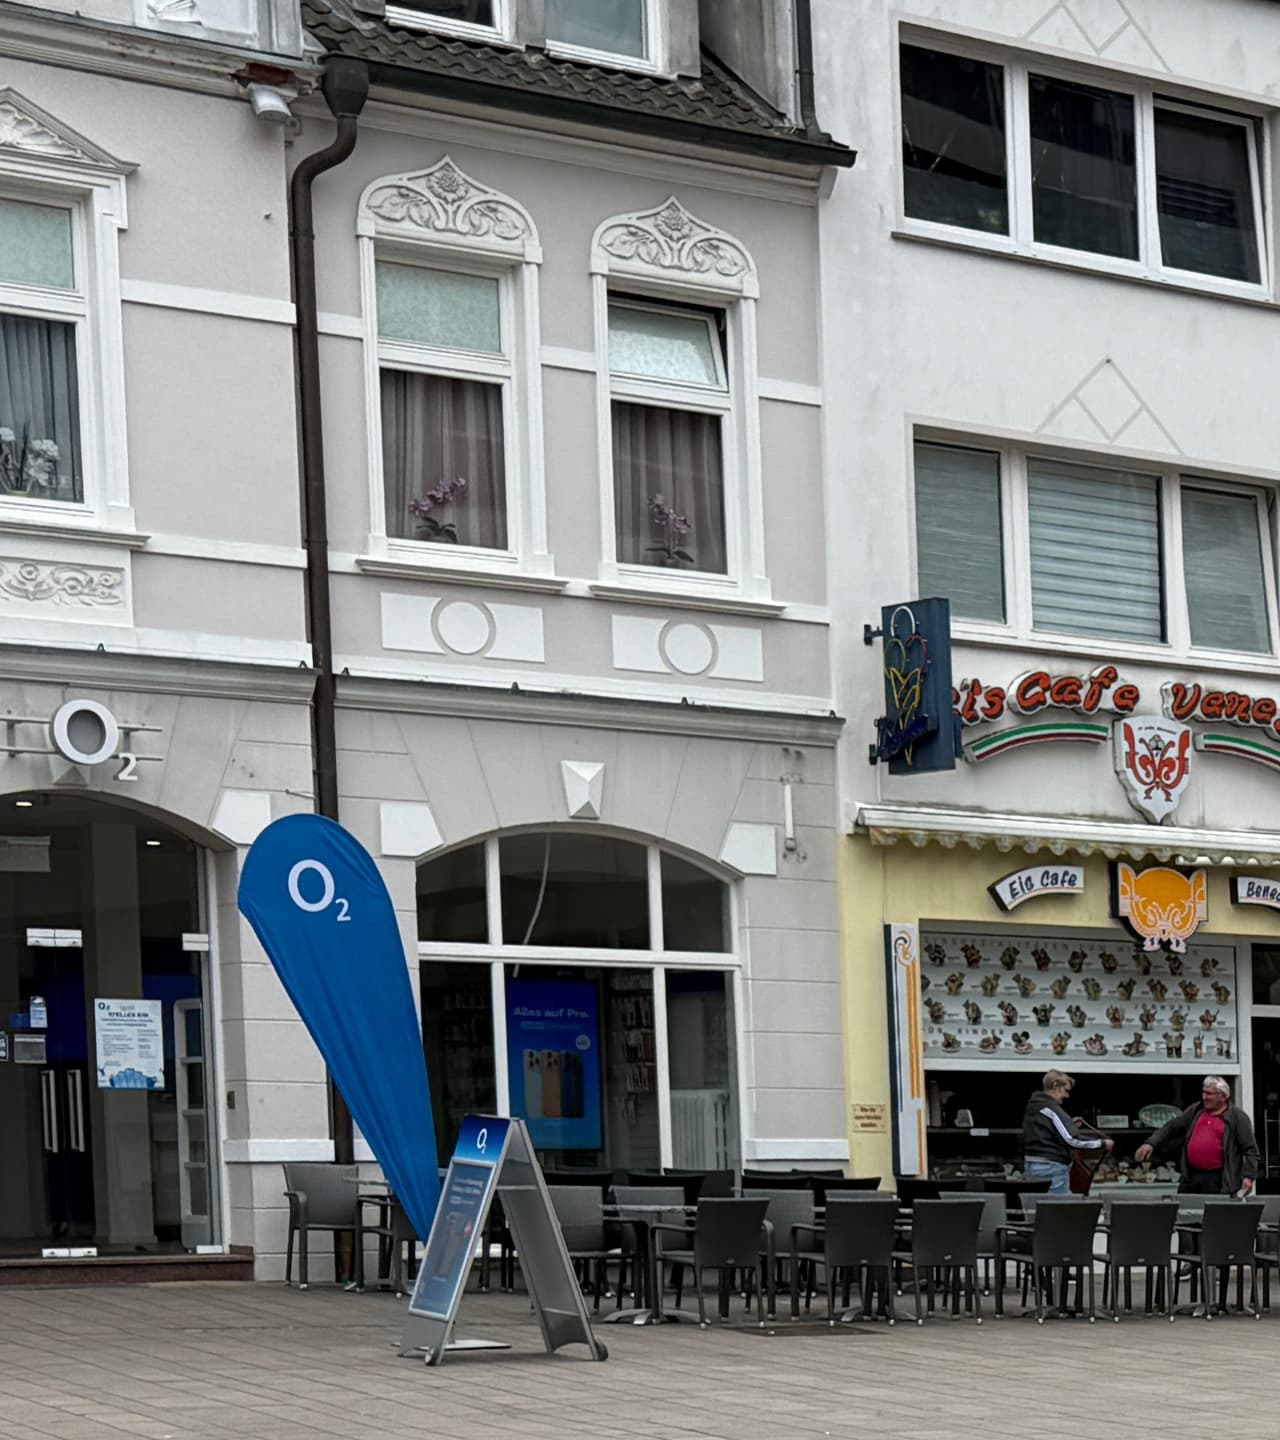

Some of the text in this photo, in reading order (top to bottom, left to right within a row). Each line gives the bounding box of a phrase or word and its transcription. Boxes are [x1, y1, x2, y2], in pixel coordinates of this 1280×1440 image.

[953, 678, 1007, 722] is
[1013, 664, 1141, 714] Cafe
[1040, 869, 1078, 888] Cafe
